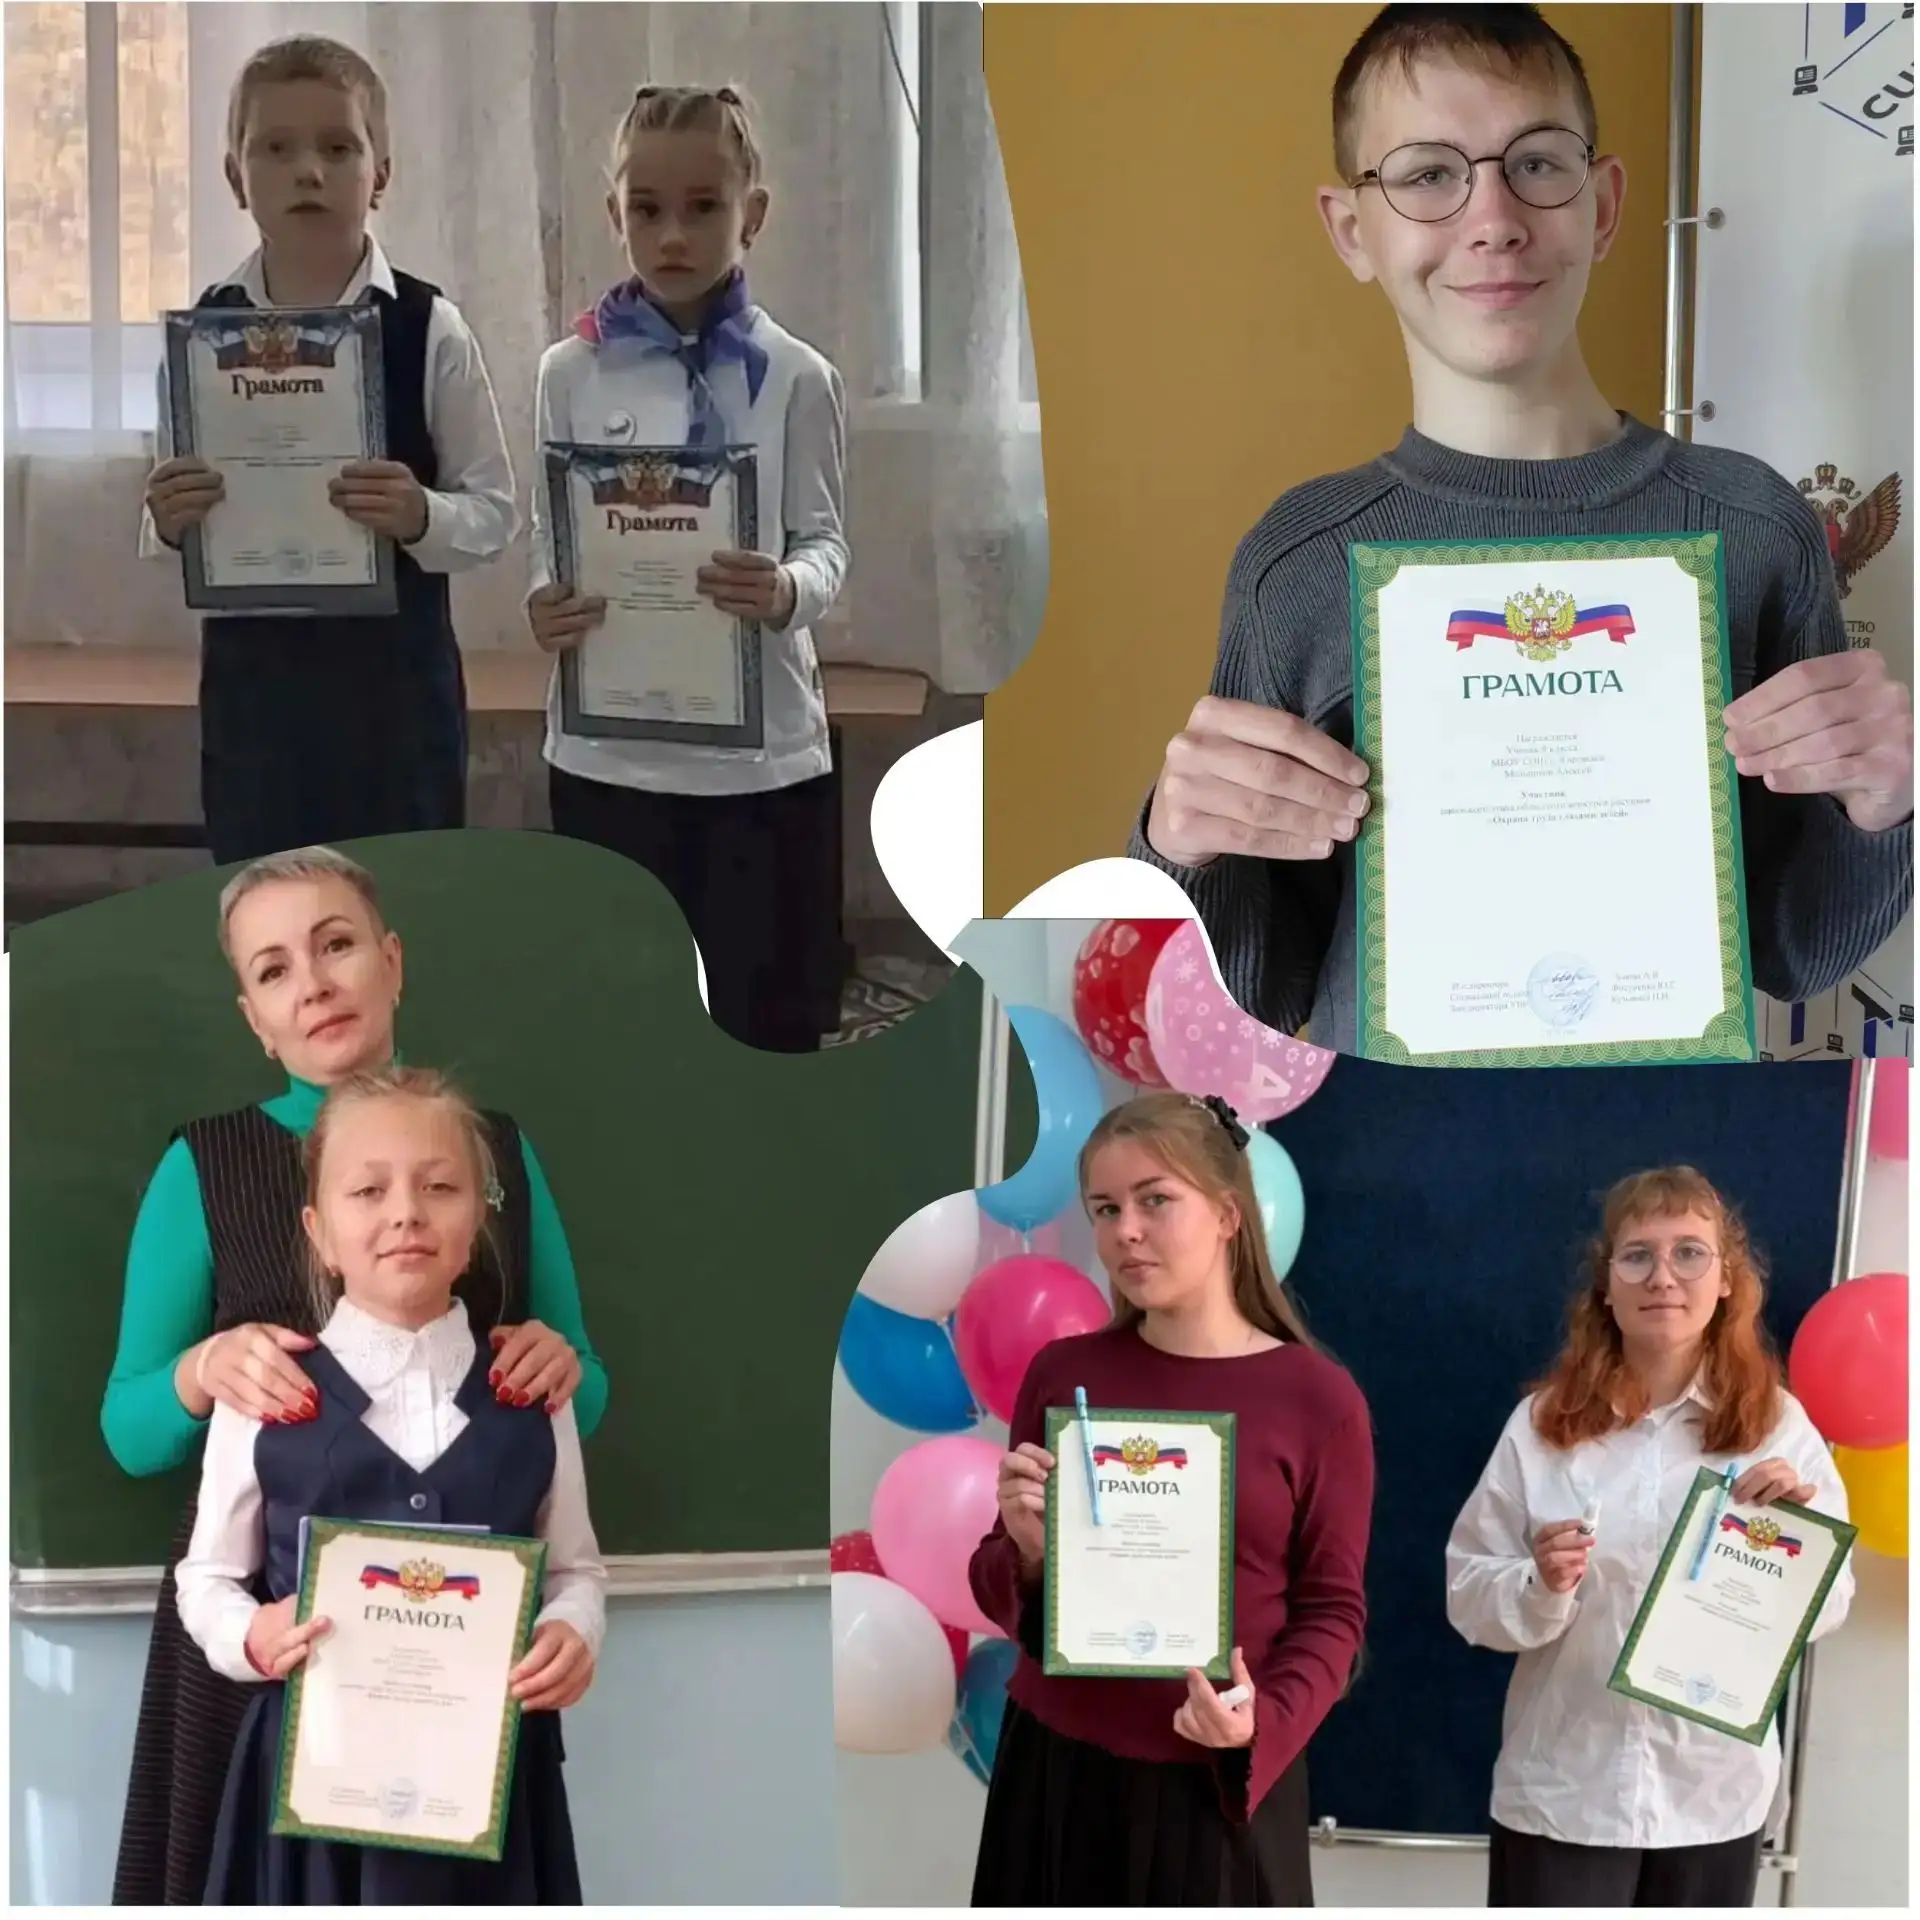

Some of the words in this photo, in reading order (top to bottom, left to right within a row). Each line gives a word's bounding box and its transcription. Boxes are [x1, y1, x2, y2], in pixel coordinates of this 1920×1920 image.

[230, 374, 325, 399] Грамота
[605, 509, 699, 536] Грамота
[1462, 669, 1624, 700] ГРАМОТА
[1097, 1479, 1181, 1496] ГРАМОТА
[1714, 1542, 1785, 1580] ГРАМОТА
[363, 1604, 466, 1632] ГРАМОТА
